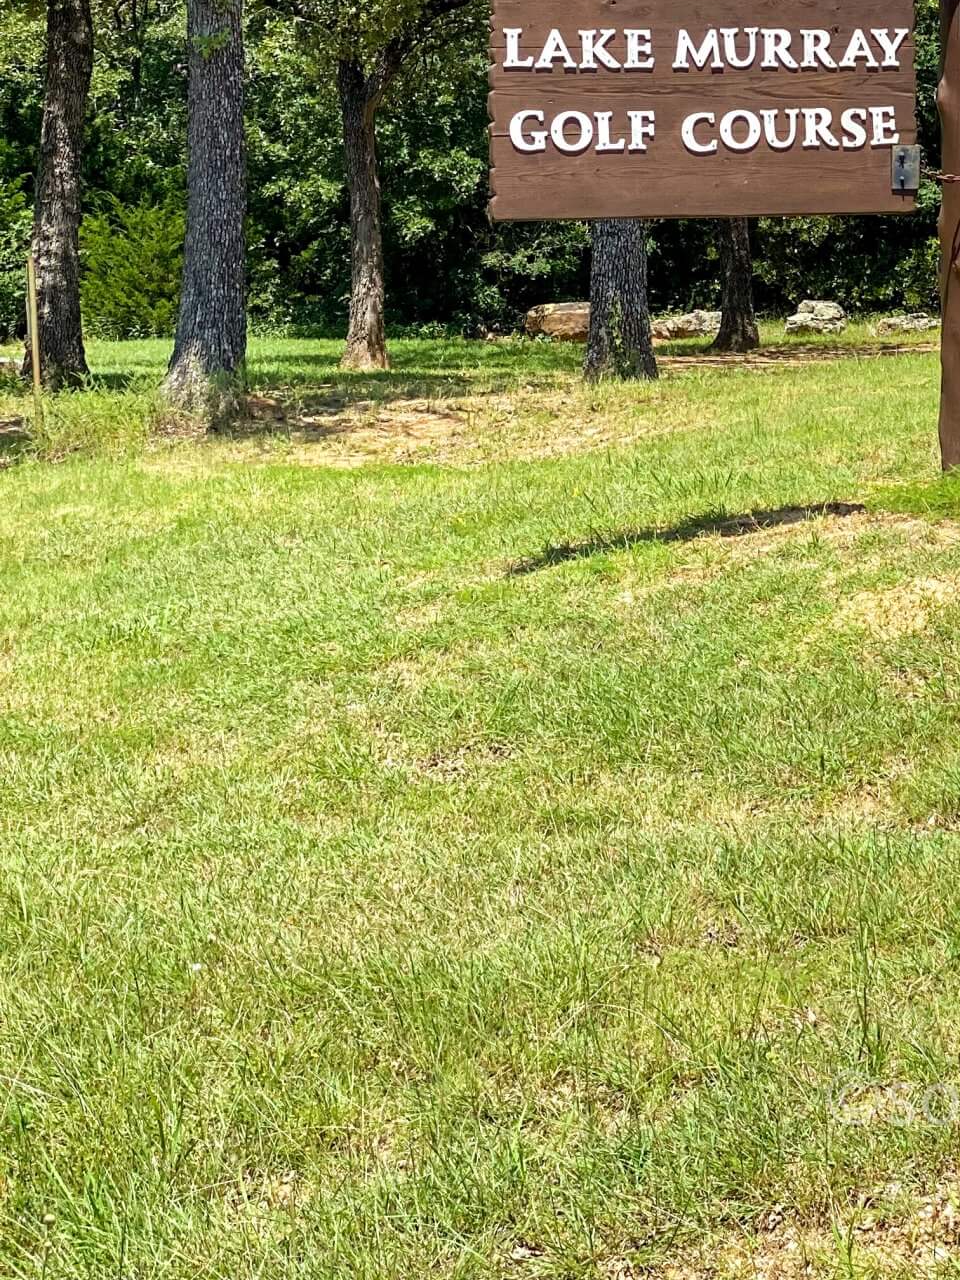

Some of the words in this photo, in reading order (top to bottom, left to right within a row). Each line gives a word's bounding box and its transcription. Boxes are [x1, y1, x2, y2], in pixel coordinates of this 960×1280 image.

[502, 27, 656, 72] LAKE
[671, 26, 908, 72] MURRAY
[509, 109, 656, 152] GOLF
[681, 105, 901, 152] COURSE
